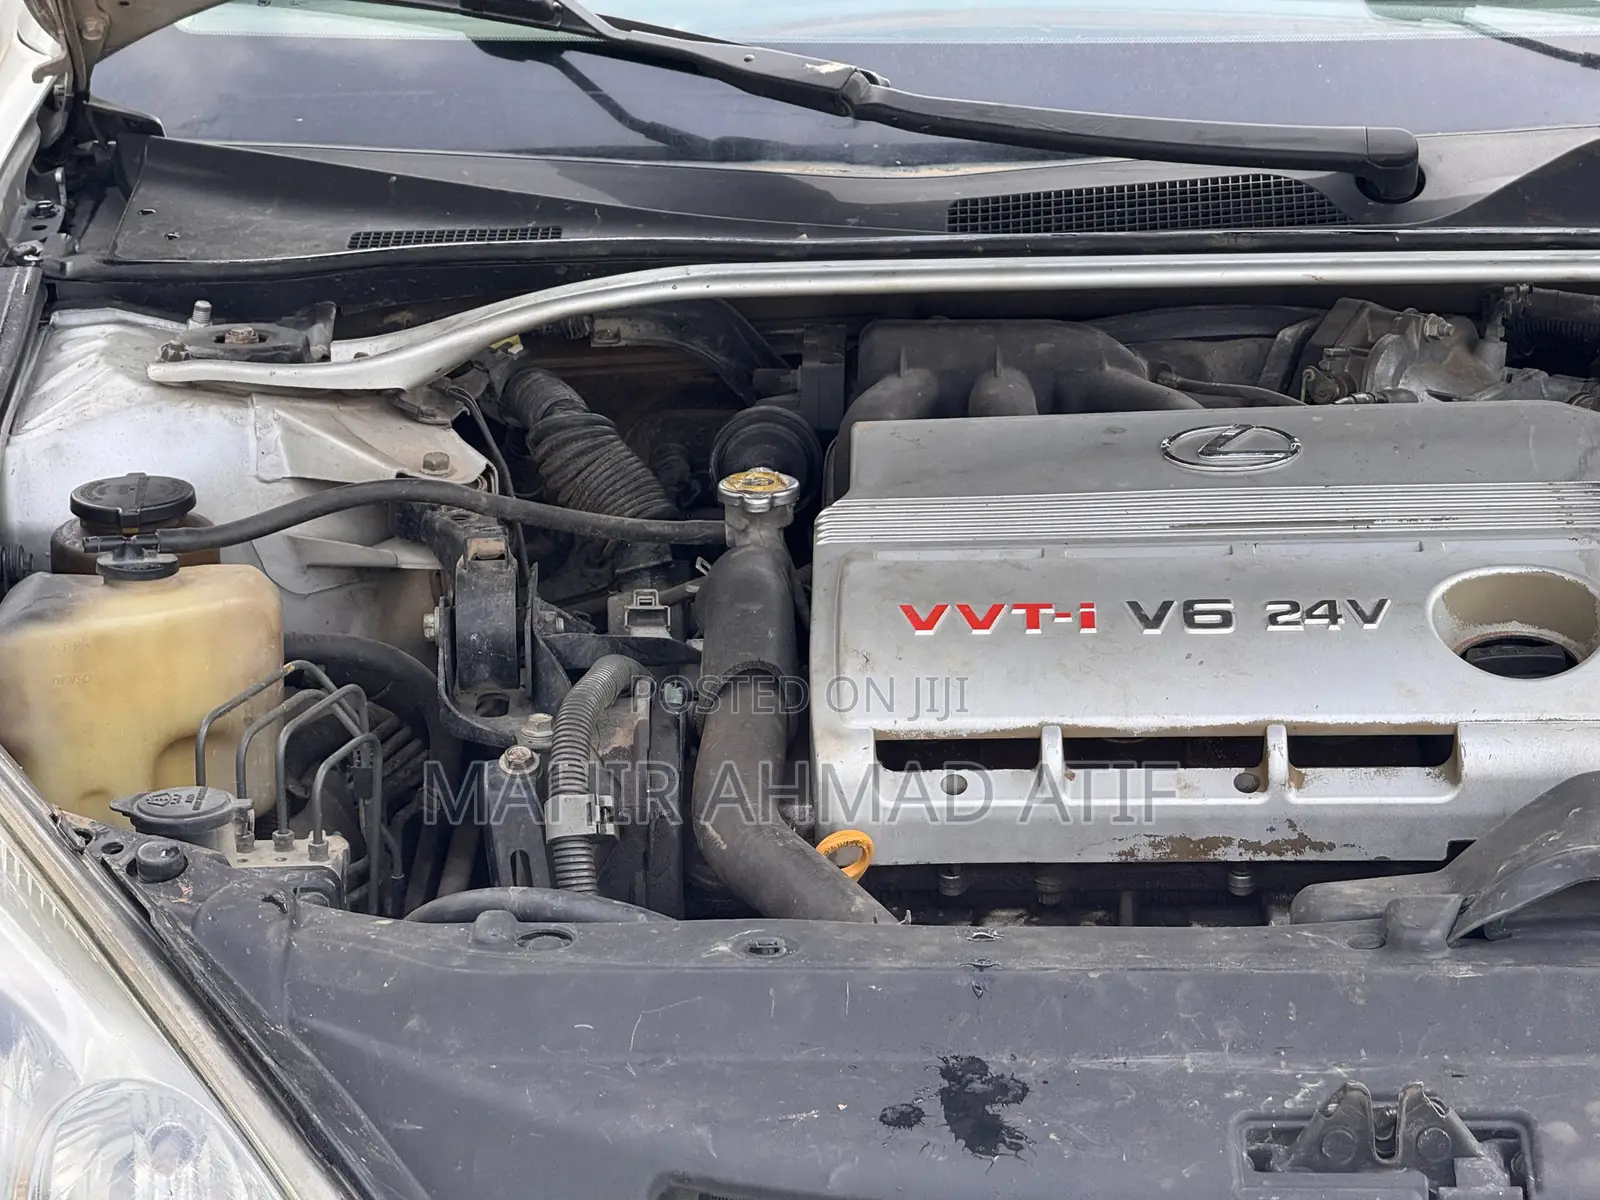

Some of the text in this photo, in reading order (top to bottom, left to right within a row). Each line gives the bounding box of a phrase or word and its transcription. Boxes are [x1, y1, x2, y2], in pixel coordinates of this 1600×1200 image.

[900, 597, 1392, 636] VVT-i V6 24V
